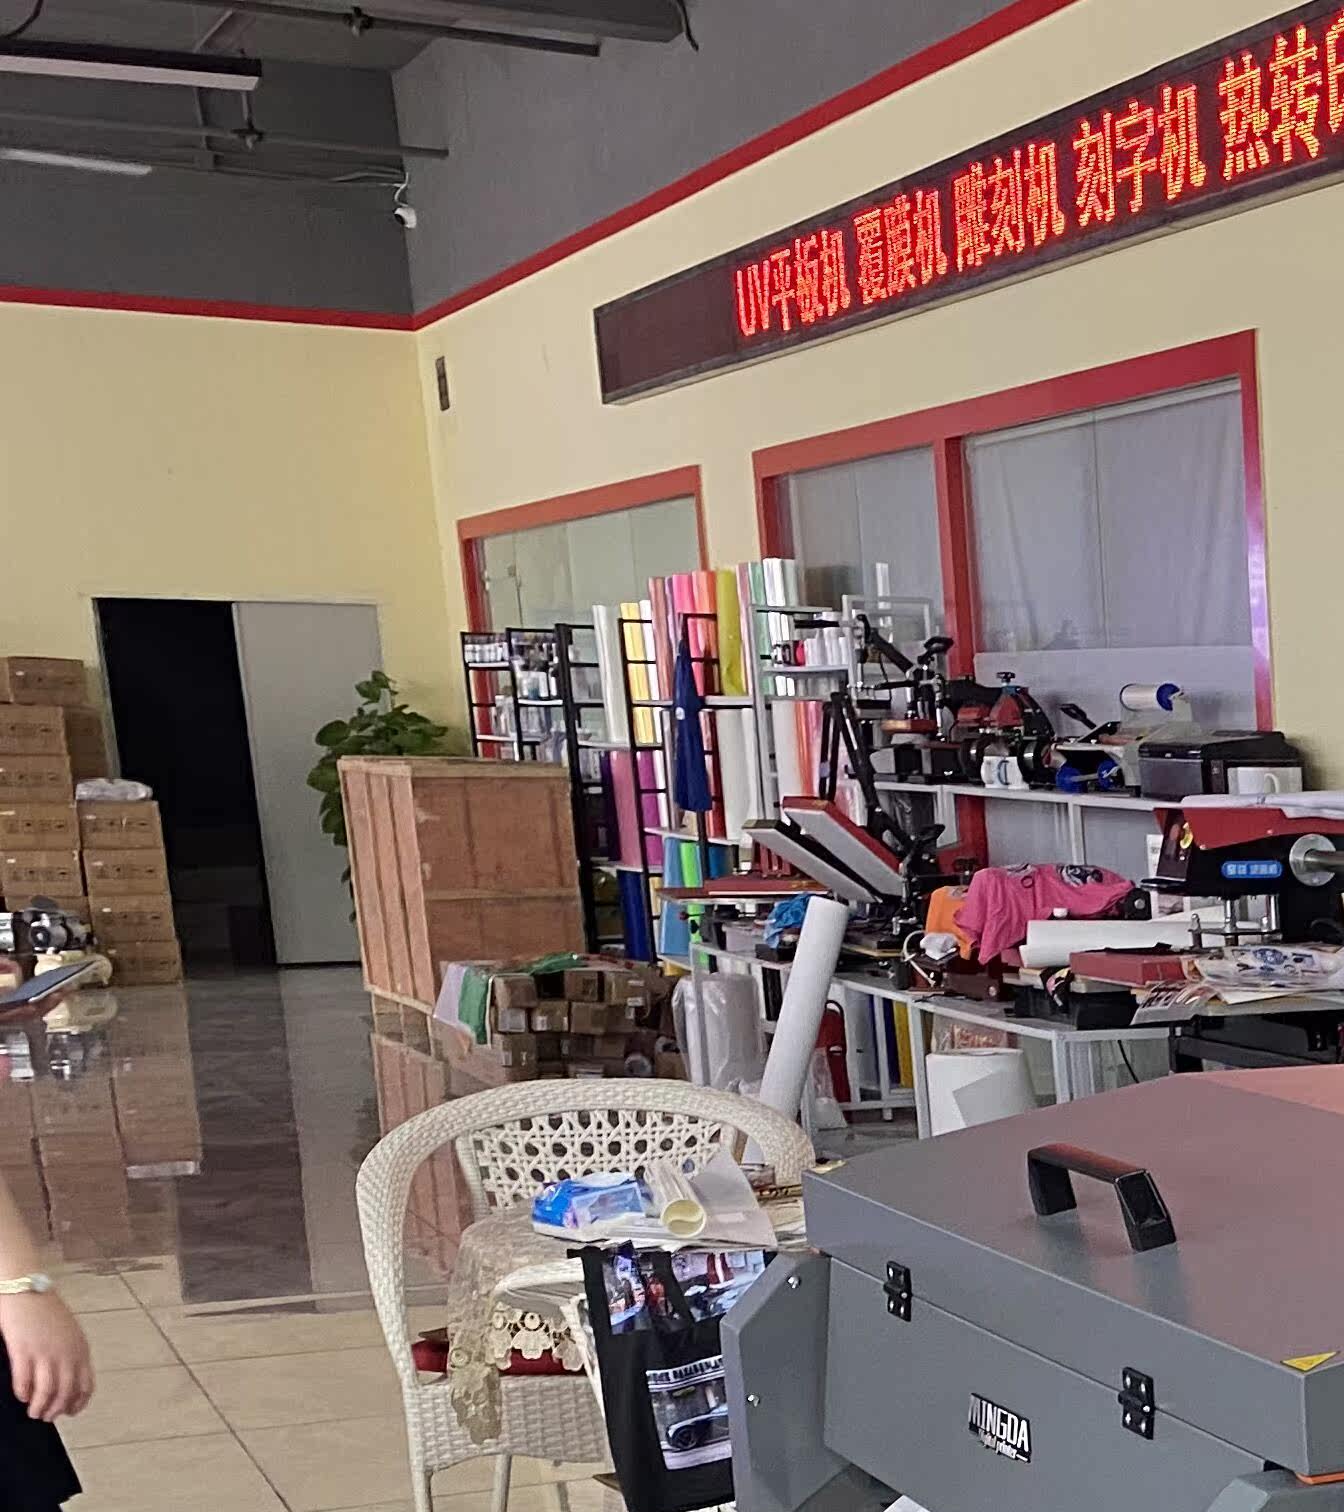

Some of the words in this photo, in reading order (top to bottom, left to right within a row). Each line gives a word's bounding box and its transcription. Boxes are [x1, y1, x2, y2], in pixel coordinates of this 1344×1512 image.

[735, 230, 850, 336] UV平板机
[854, 189, 948, 304] 覆膜机
[953, 144, 1066, 272] 雕刻机
[1073, 83, 1206, 226] 刻字机
[967, 1394, 1031, 1453] MINGDA
